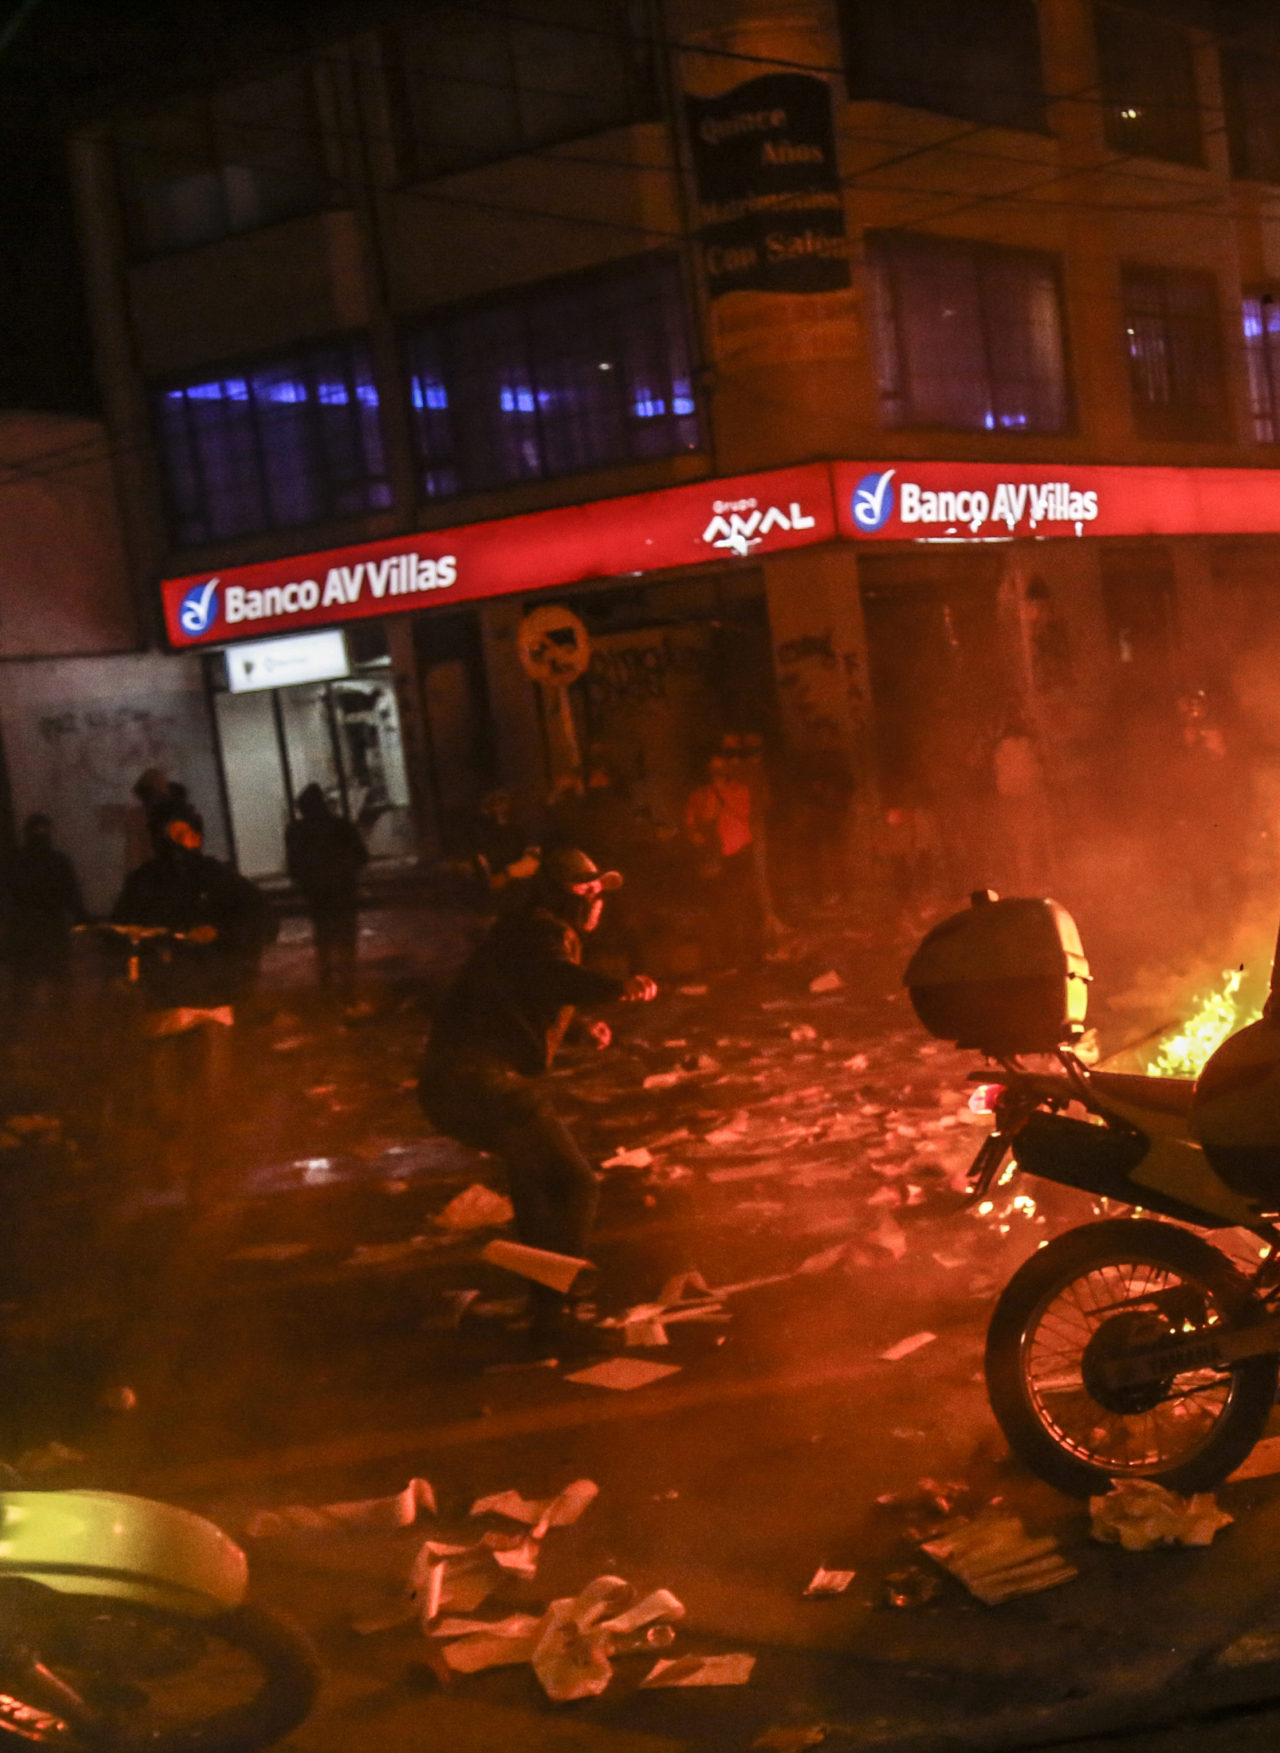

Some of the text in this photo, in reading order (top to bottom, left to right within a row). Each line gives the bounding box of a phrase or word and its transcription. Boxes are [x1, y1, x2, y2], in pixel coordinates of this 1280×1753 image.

[900, 482, 1099, 524] Banco AV Villas
[224, 551, 458, 625] Banco AV Villas
